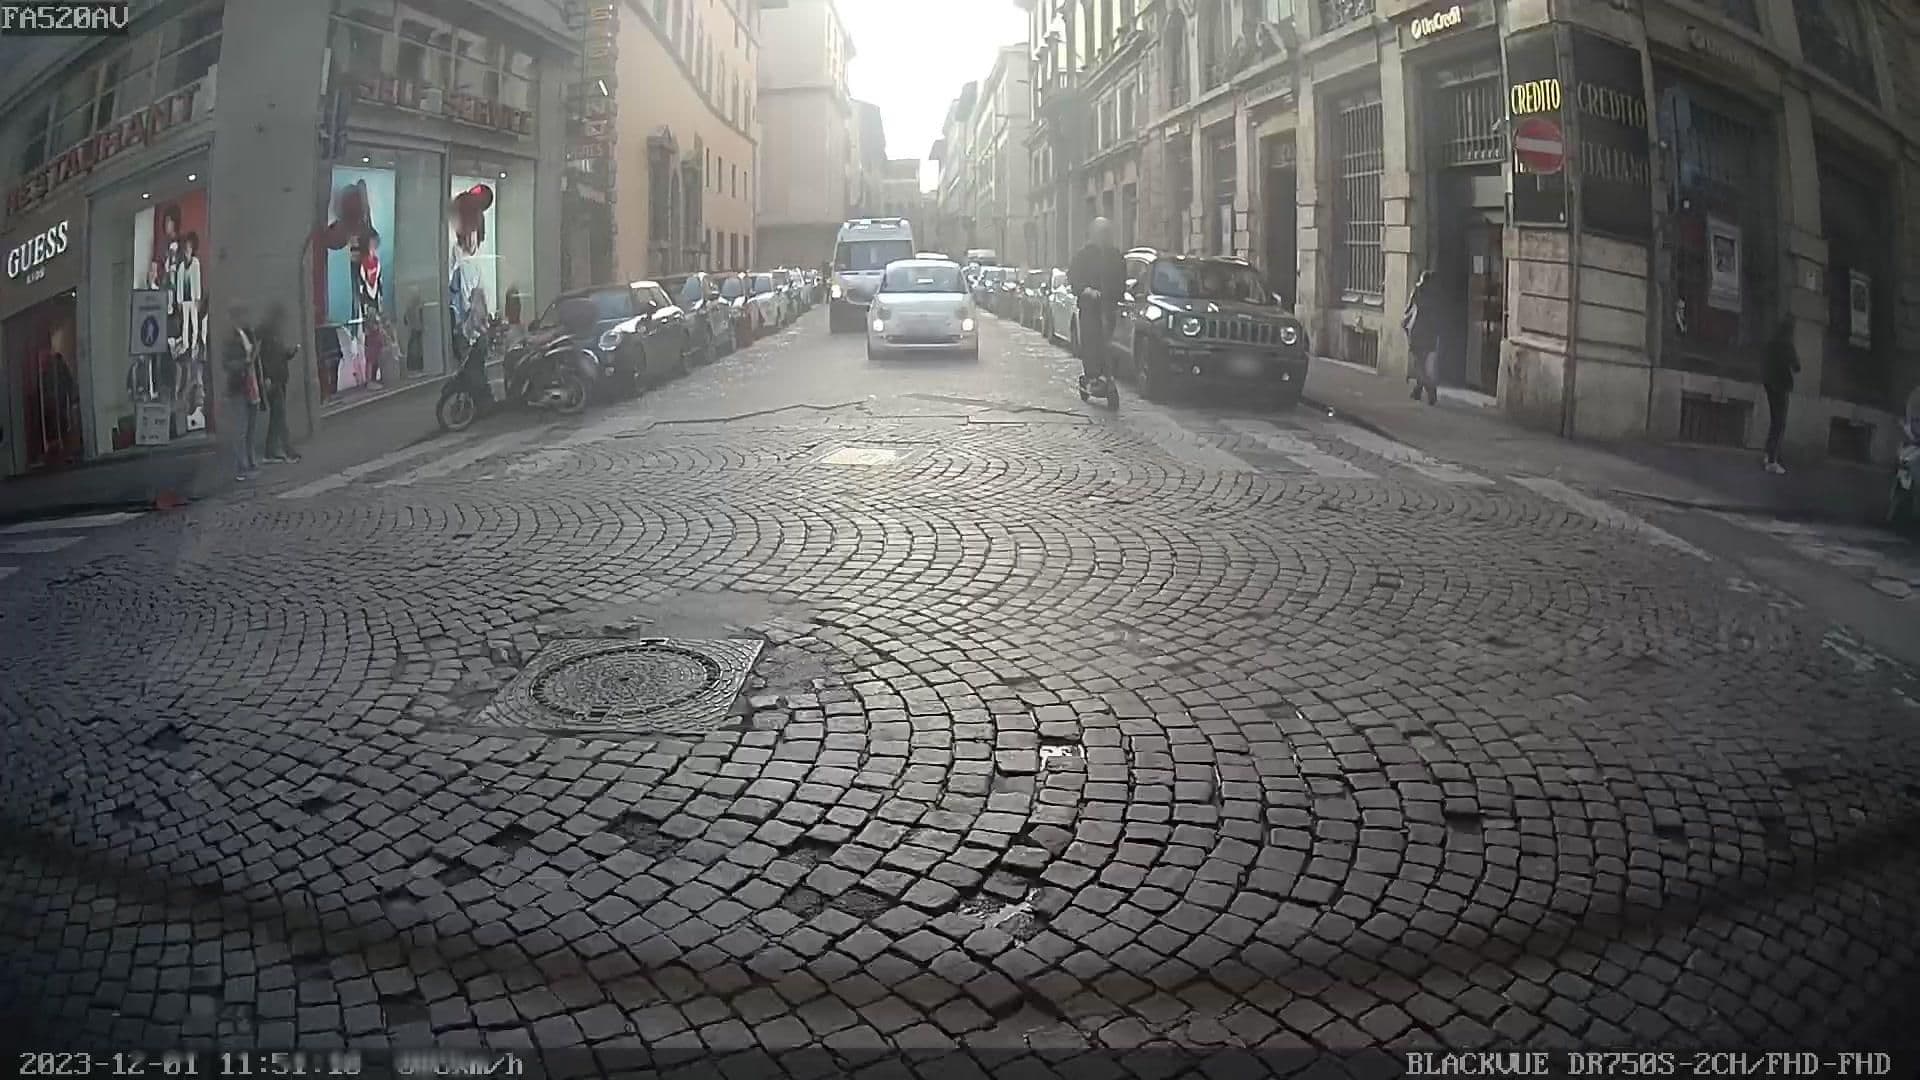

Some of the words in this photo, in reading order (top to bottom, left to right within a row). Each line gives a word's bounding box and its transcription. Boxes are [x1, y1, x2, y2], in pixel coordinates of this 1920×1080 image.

[1511, 78, 1562, 115] CREDITO
[1577, 81, 1647, 128] CREDITO
[8, 220, 68, 278] GUESS
